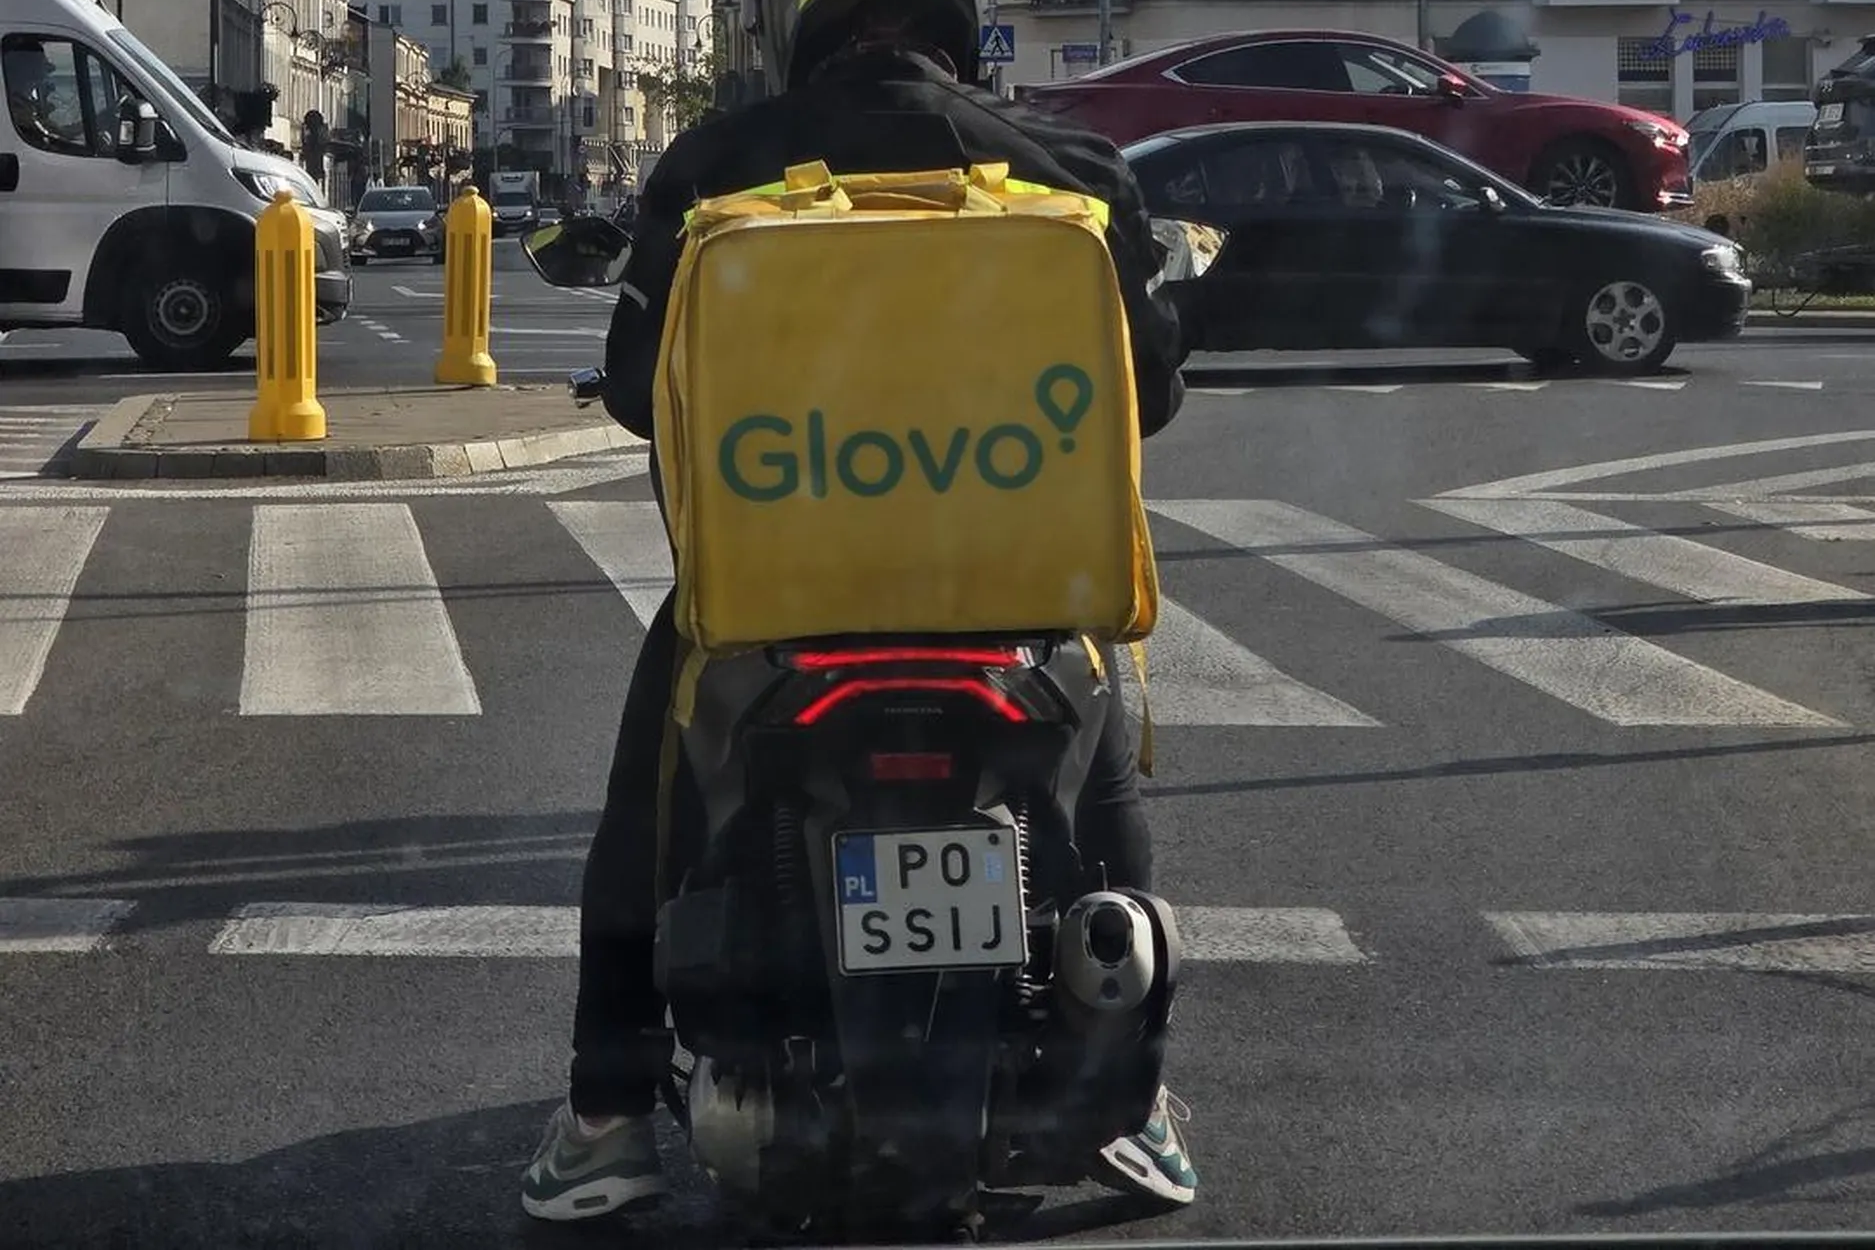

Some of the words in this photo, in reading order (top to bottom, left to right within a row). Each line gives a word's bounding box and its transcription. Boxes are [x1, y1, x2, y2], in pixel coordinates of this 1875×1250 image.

[719, 408, 1044, 502] Glovo
[845, 876, 874, 897] PL
[860, 905, 1002, 955] SSIJ
